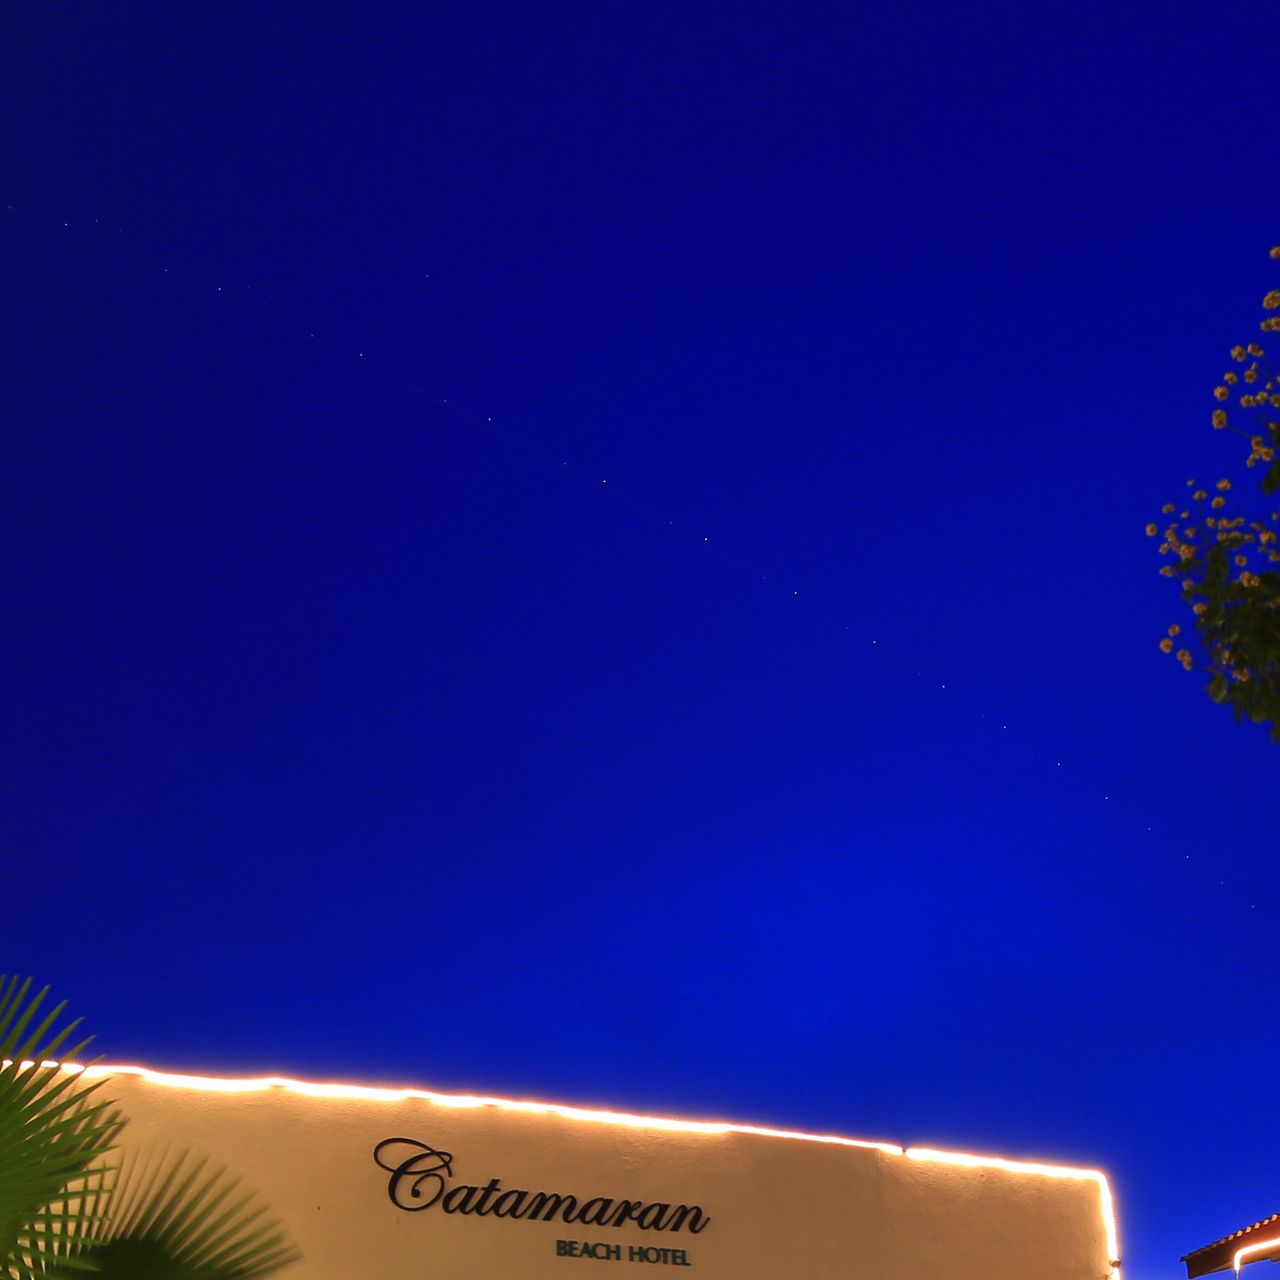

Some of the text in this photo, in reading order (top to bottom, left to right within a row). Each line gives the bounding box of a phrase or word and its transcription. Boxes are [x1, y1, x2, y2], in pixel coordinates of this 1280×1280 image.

[373, 1137, 710, 1234] Catamaran
[556, 1239, 692, 1266] BEACH HOTEL
